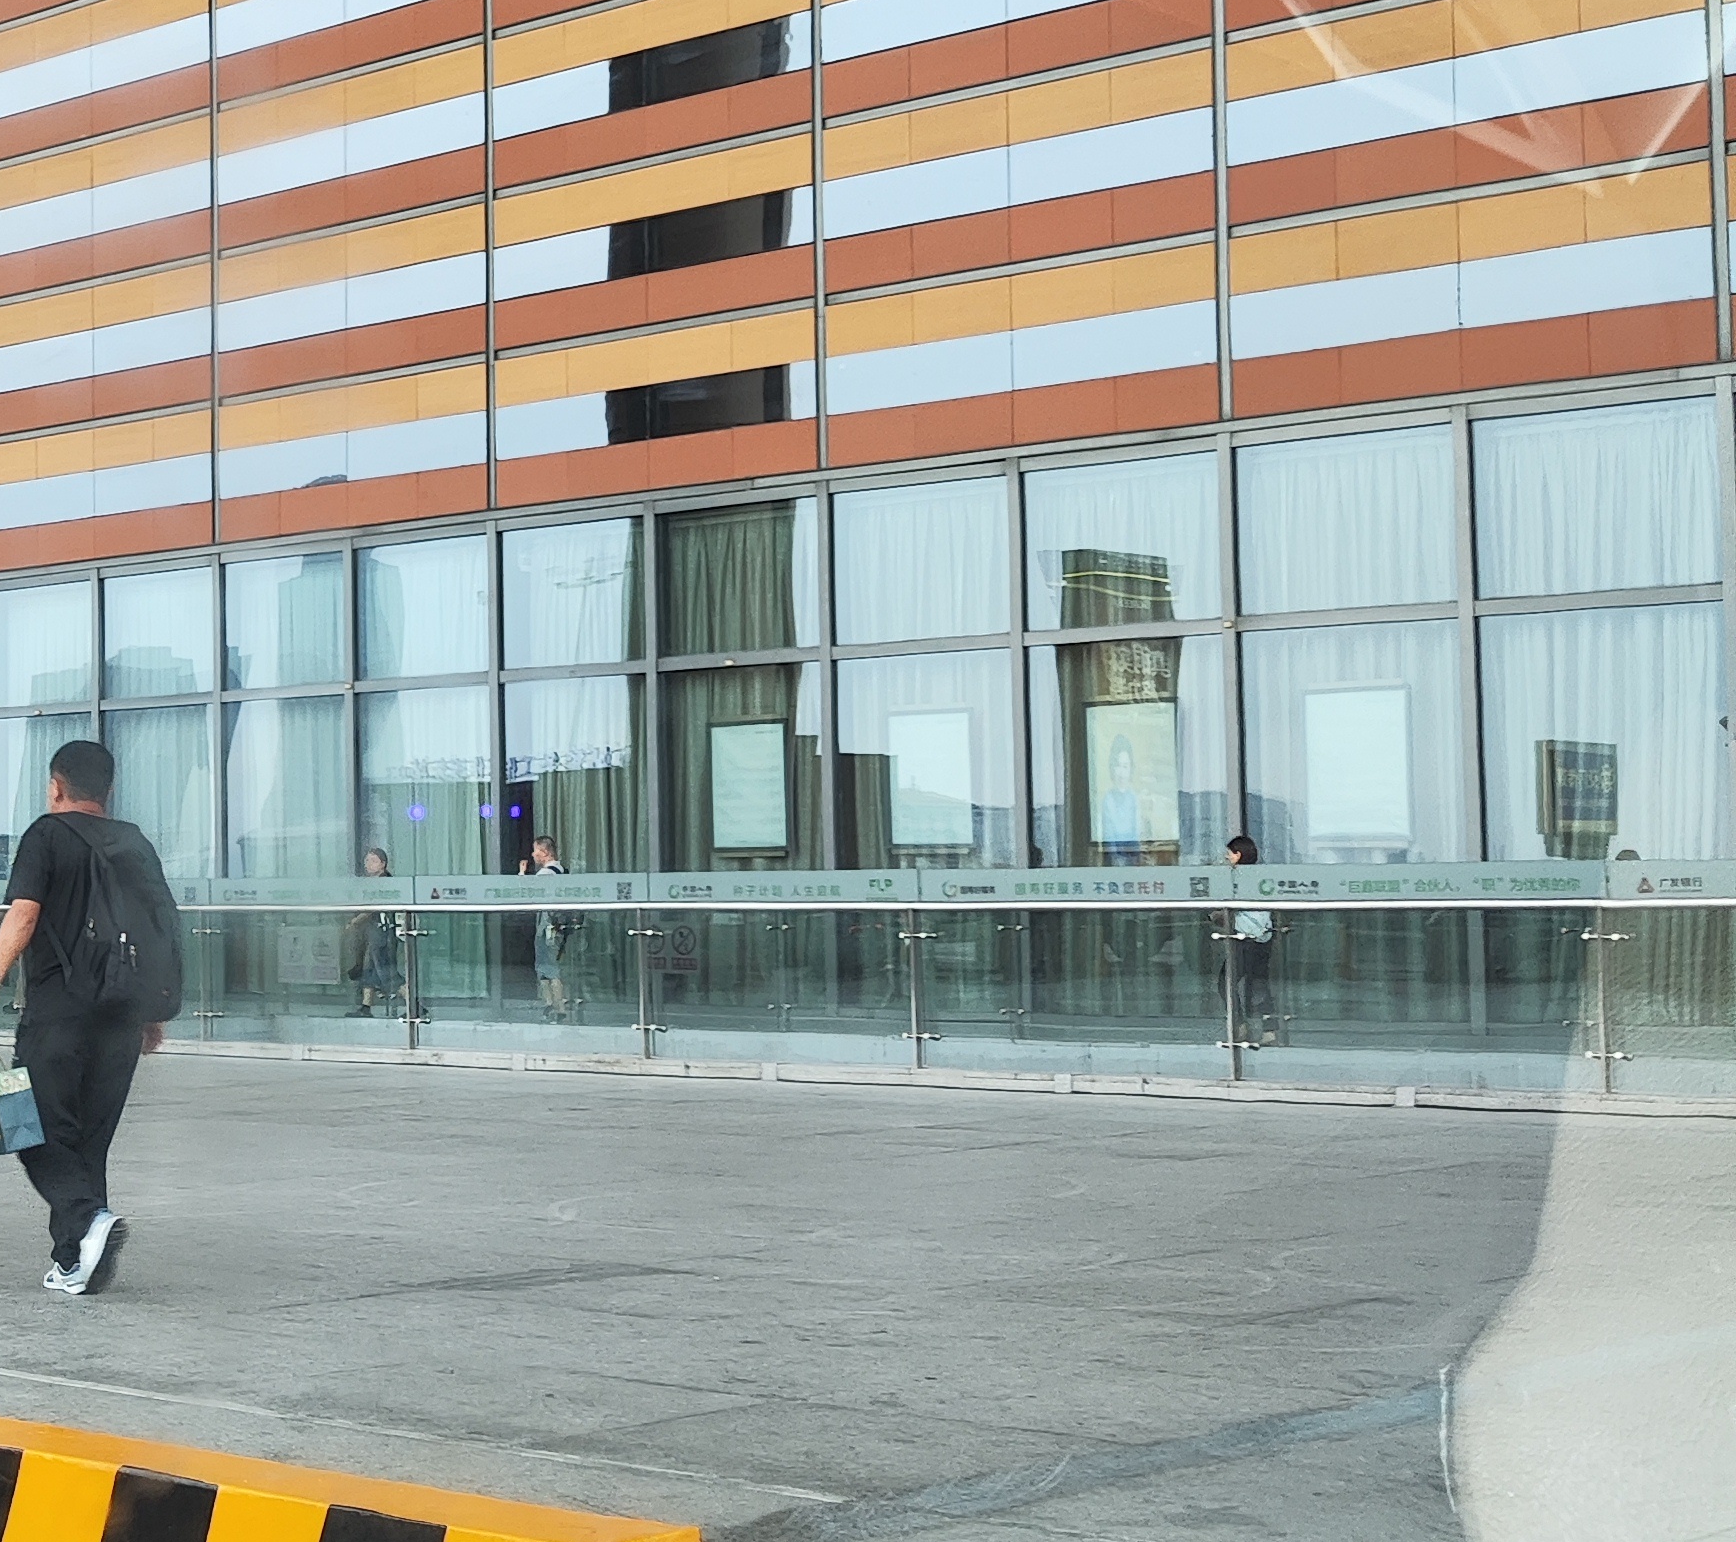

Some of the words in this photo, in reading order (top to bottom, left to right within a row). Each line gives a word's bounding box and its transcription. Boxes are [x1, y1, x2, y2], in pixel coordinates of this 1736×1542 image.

[1277, 880, 1319, 888] 中国人寿
[1659, 877, 1702, 888] 广发银行
